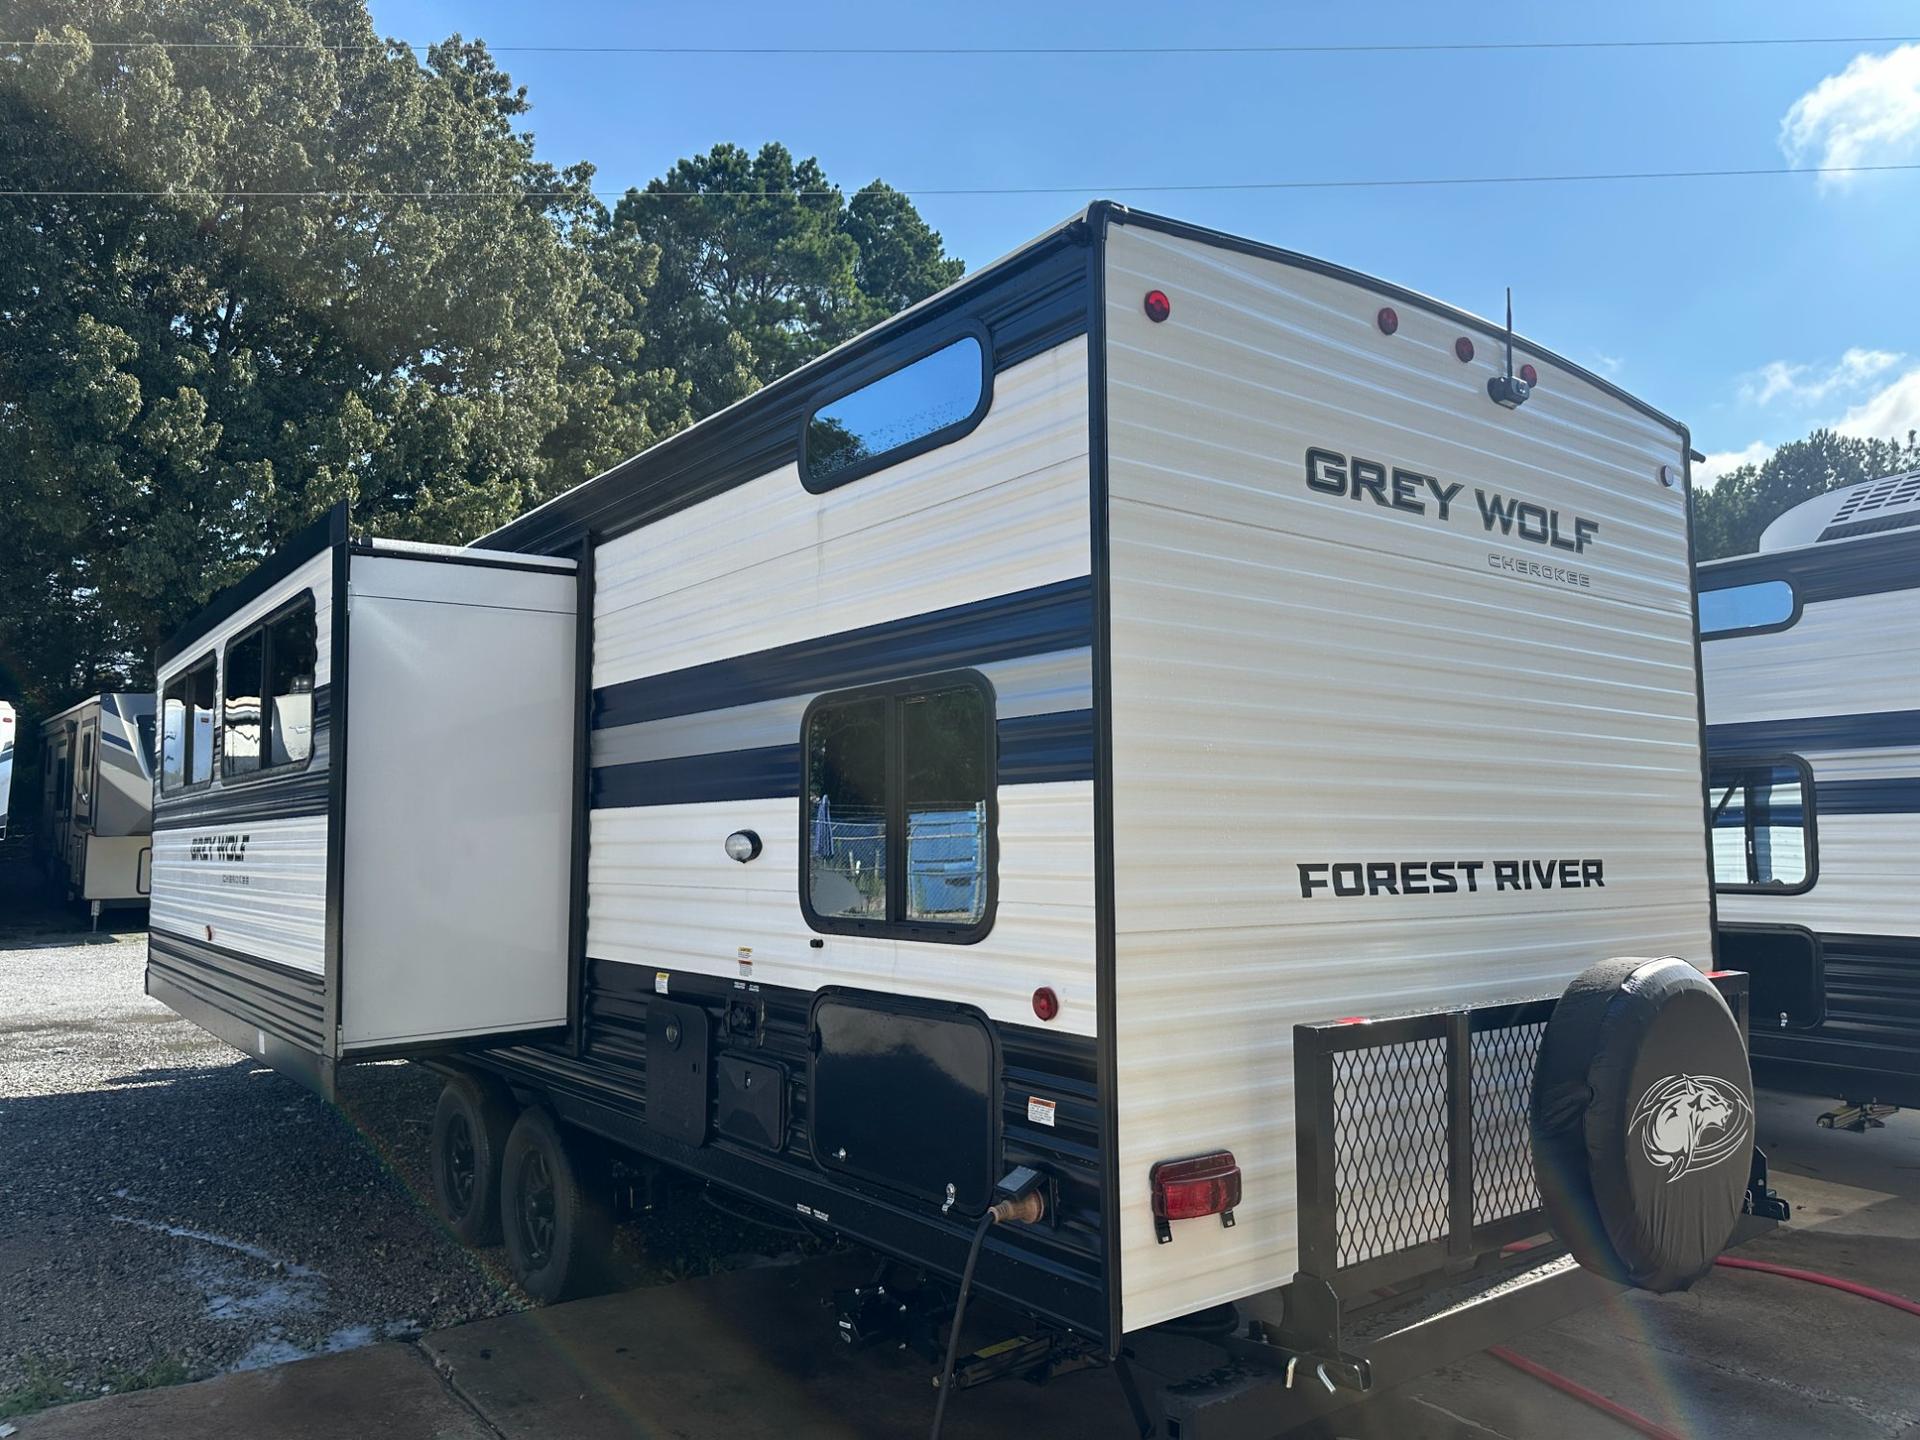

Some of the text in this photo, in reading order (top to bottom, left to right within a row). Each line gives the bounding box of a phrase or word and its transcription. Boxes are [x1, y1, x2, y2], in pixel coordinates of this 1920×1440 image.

[1305, 446, 1599, 554] GREY WOLF
[1487, 553, 1590, 587] CHEROKEE
[190, 834, 250, 862] GREY WOLF
[1296, 859, 1605, 898] FOREST RIVER
